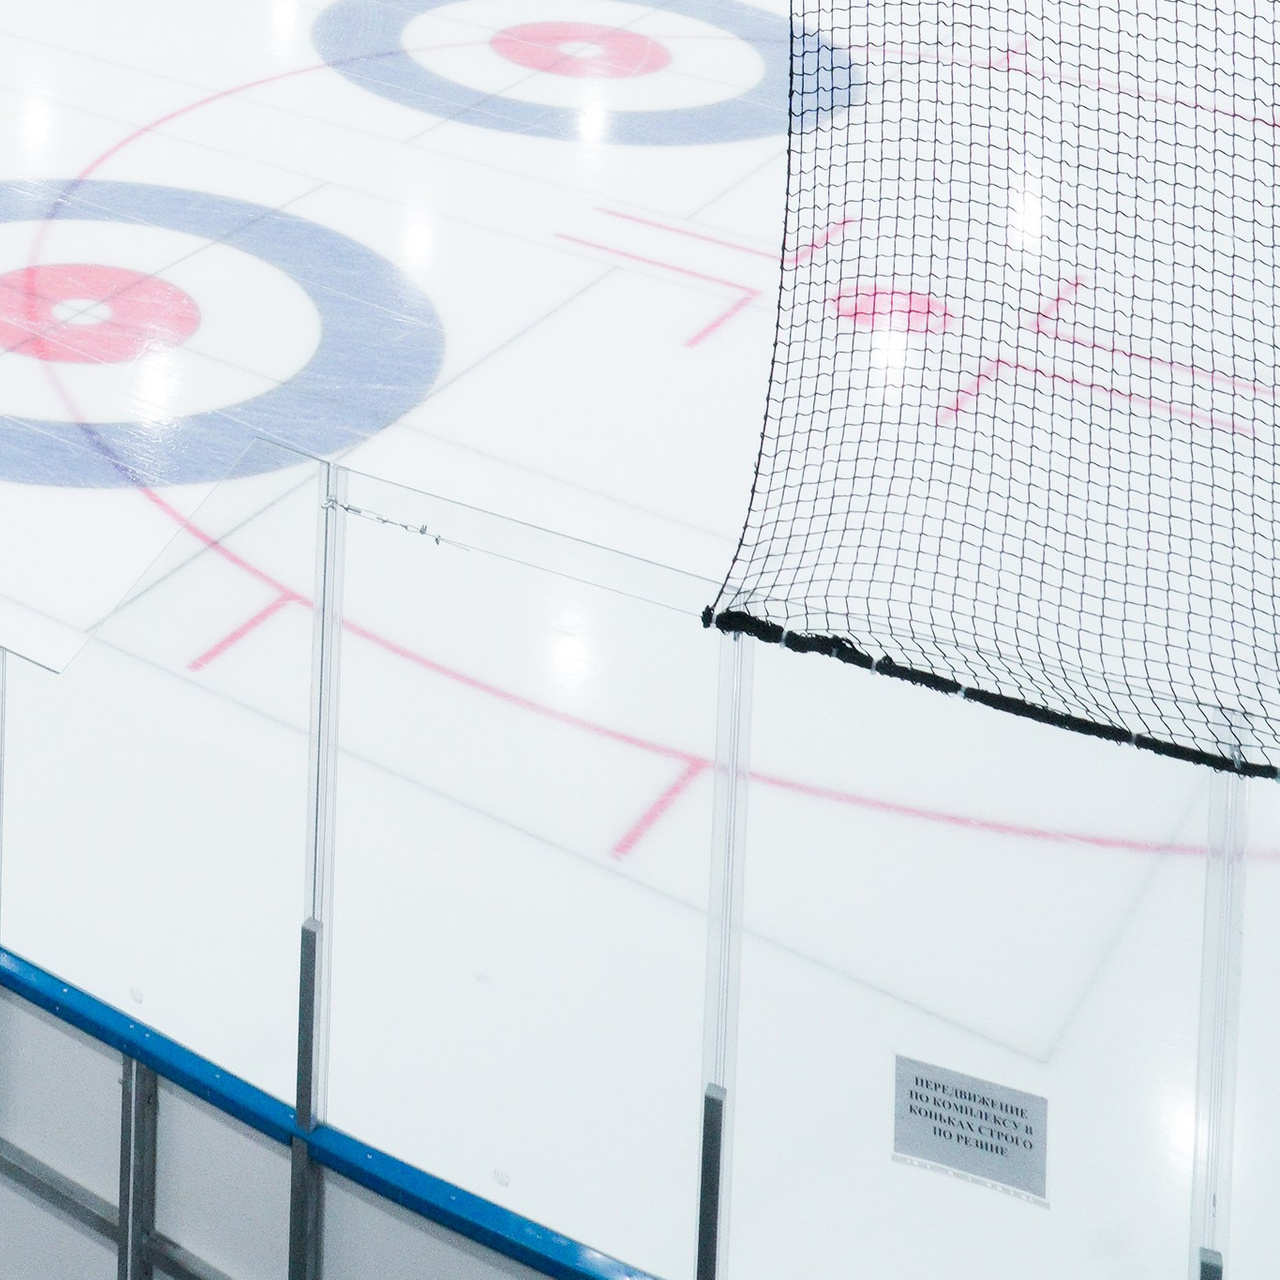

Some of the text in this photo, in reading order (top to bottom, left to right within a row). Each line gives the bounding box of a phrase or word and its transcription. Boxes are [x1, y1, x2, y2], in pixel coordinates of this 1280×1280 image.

[908, 1089, 929, 1104] ПО
[933, 1097, 1021, 1130] КОМПЛЕКСУ
[914, 1076, 1028, 1119] ПЕРЕДВИЖЕНИЕ
[909, 1104, 1034, 1150] КОНЬКАХ СТРОГО
[933, 1126, 1009, 1157] ПО РЕЗИНЕ
